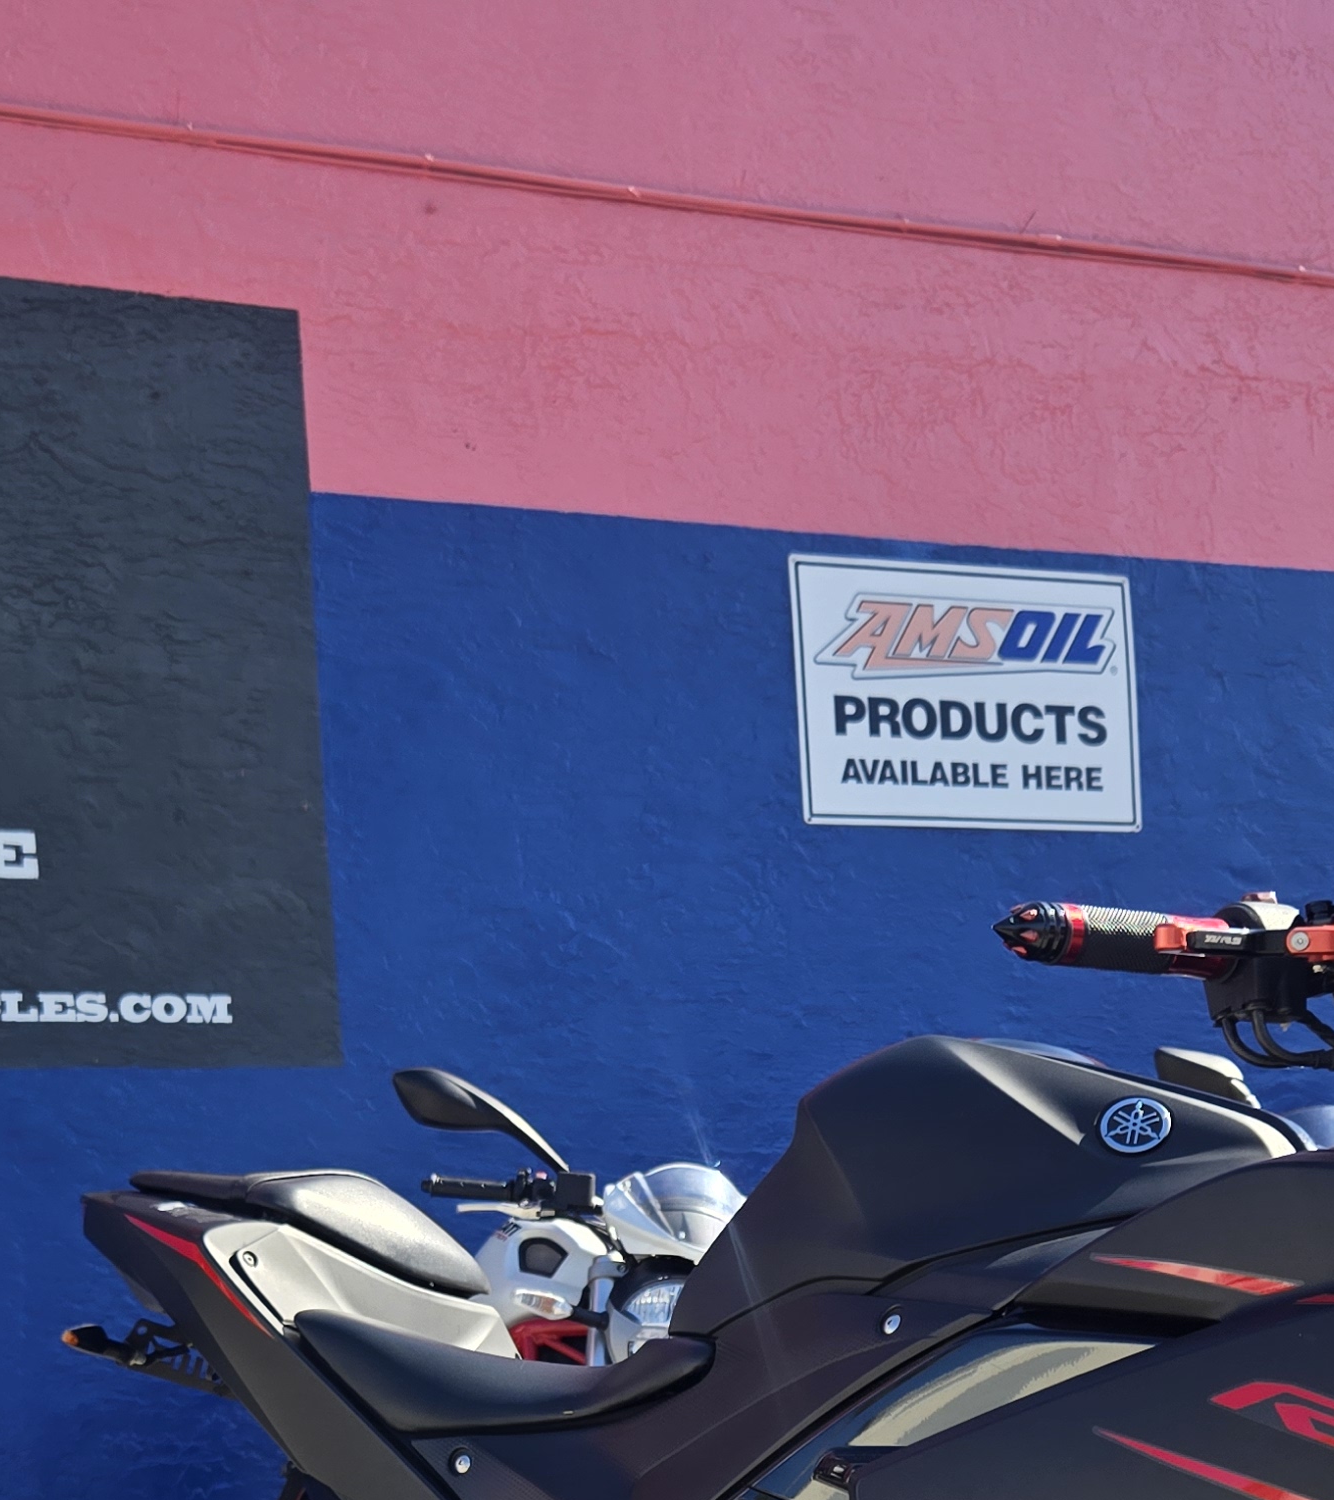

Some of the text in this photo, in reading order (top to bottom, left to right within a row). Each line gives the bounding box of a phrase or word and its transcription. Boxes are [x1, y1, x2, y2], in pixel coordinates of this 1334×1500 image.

[831, 600, 1105, 671] AMSOIL
[833, 695, 1107, 746] PRODUCTS
[841, 758, 1104, 791] AVAILABLE HERE
